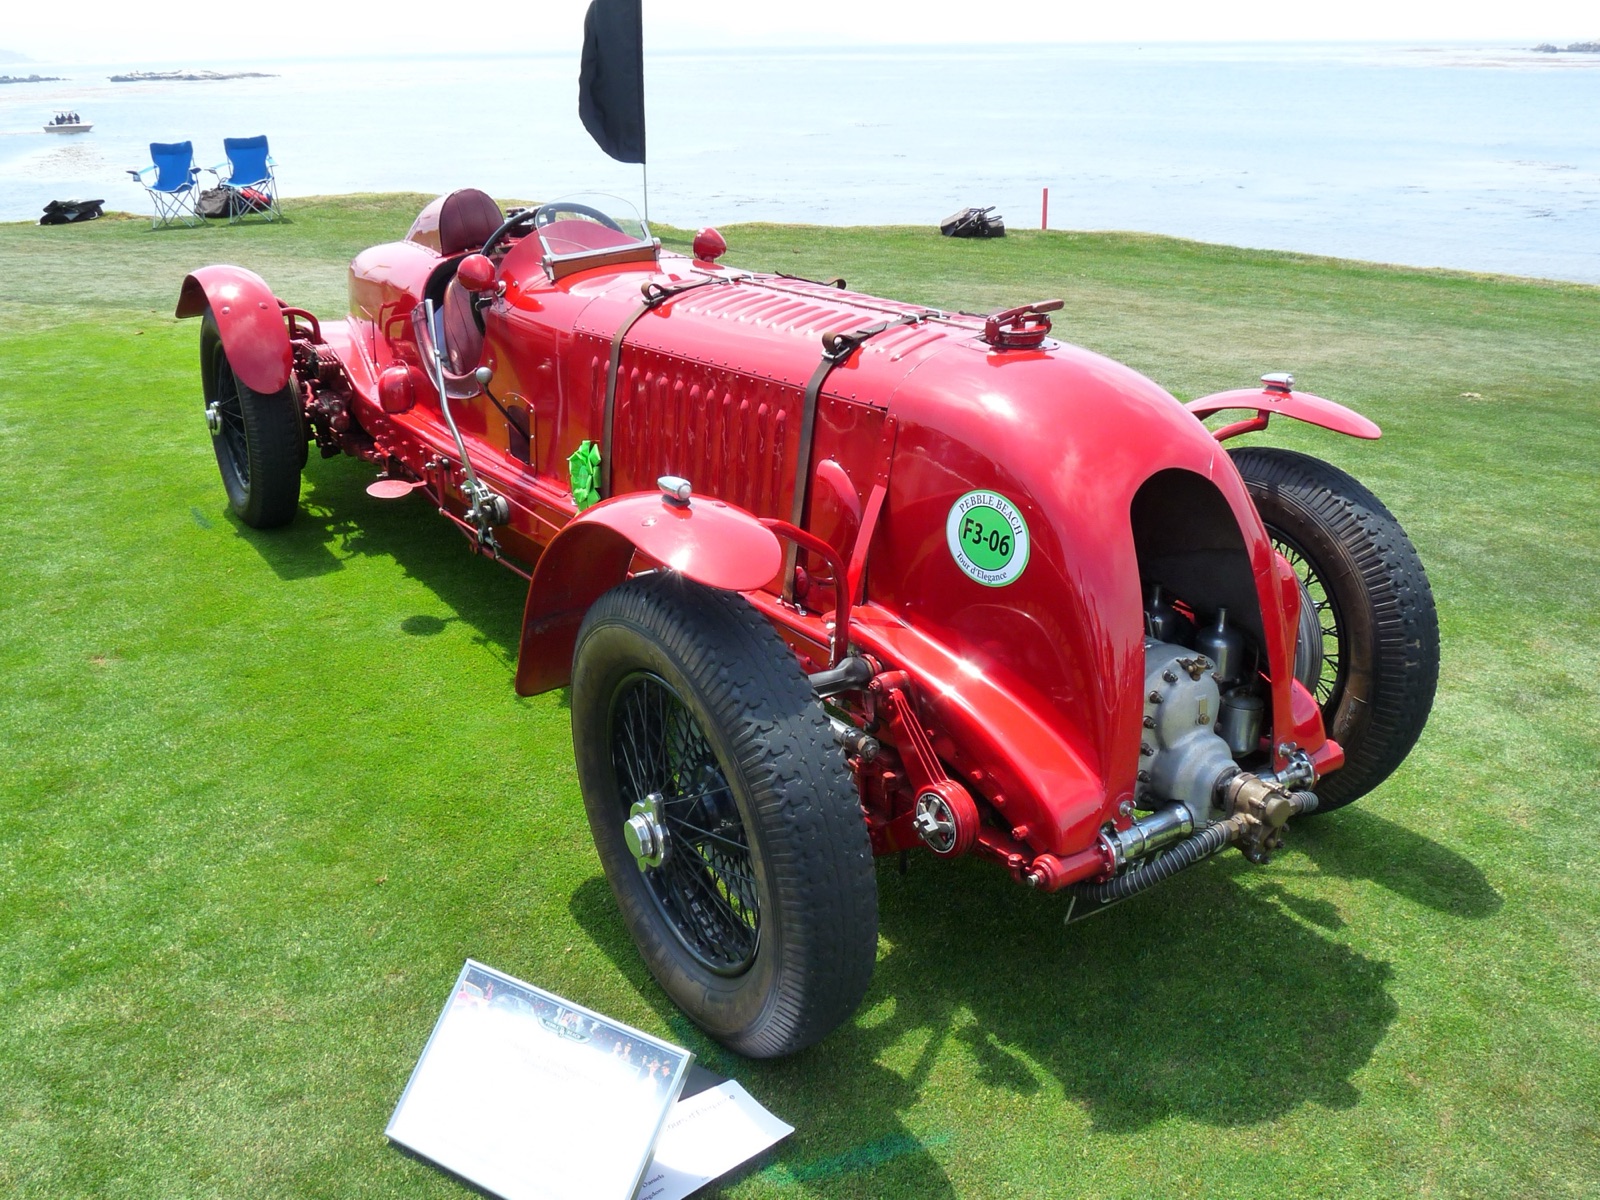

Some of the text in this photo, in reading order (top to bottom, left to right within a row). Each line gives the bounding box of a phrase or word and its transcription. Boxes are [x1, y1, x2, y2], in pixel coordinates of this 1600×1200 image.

[959, 495, 1023, 535] PEBBLE BEACH
[962, 518, 1010, 556] F3-06
[956, 551, 1007, 583] Tour d'Elegance
